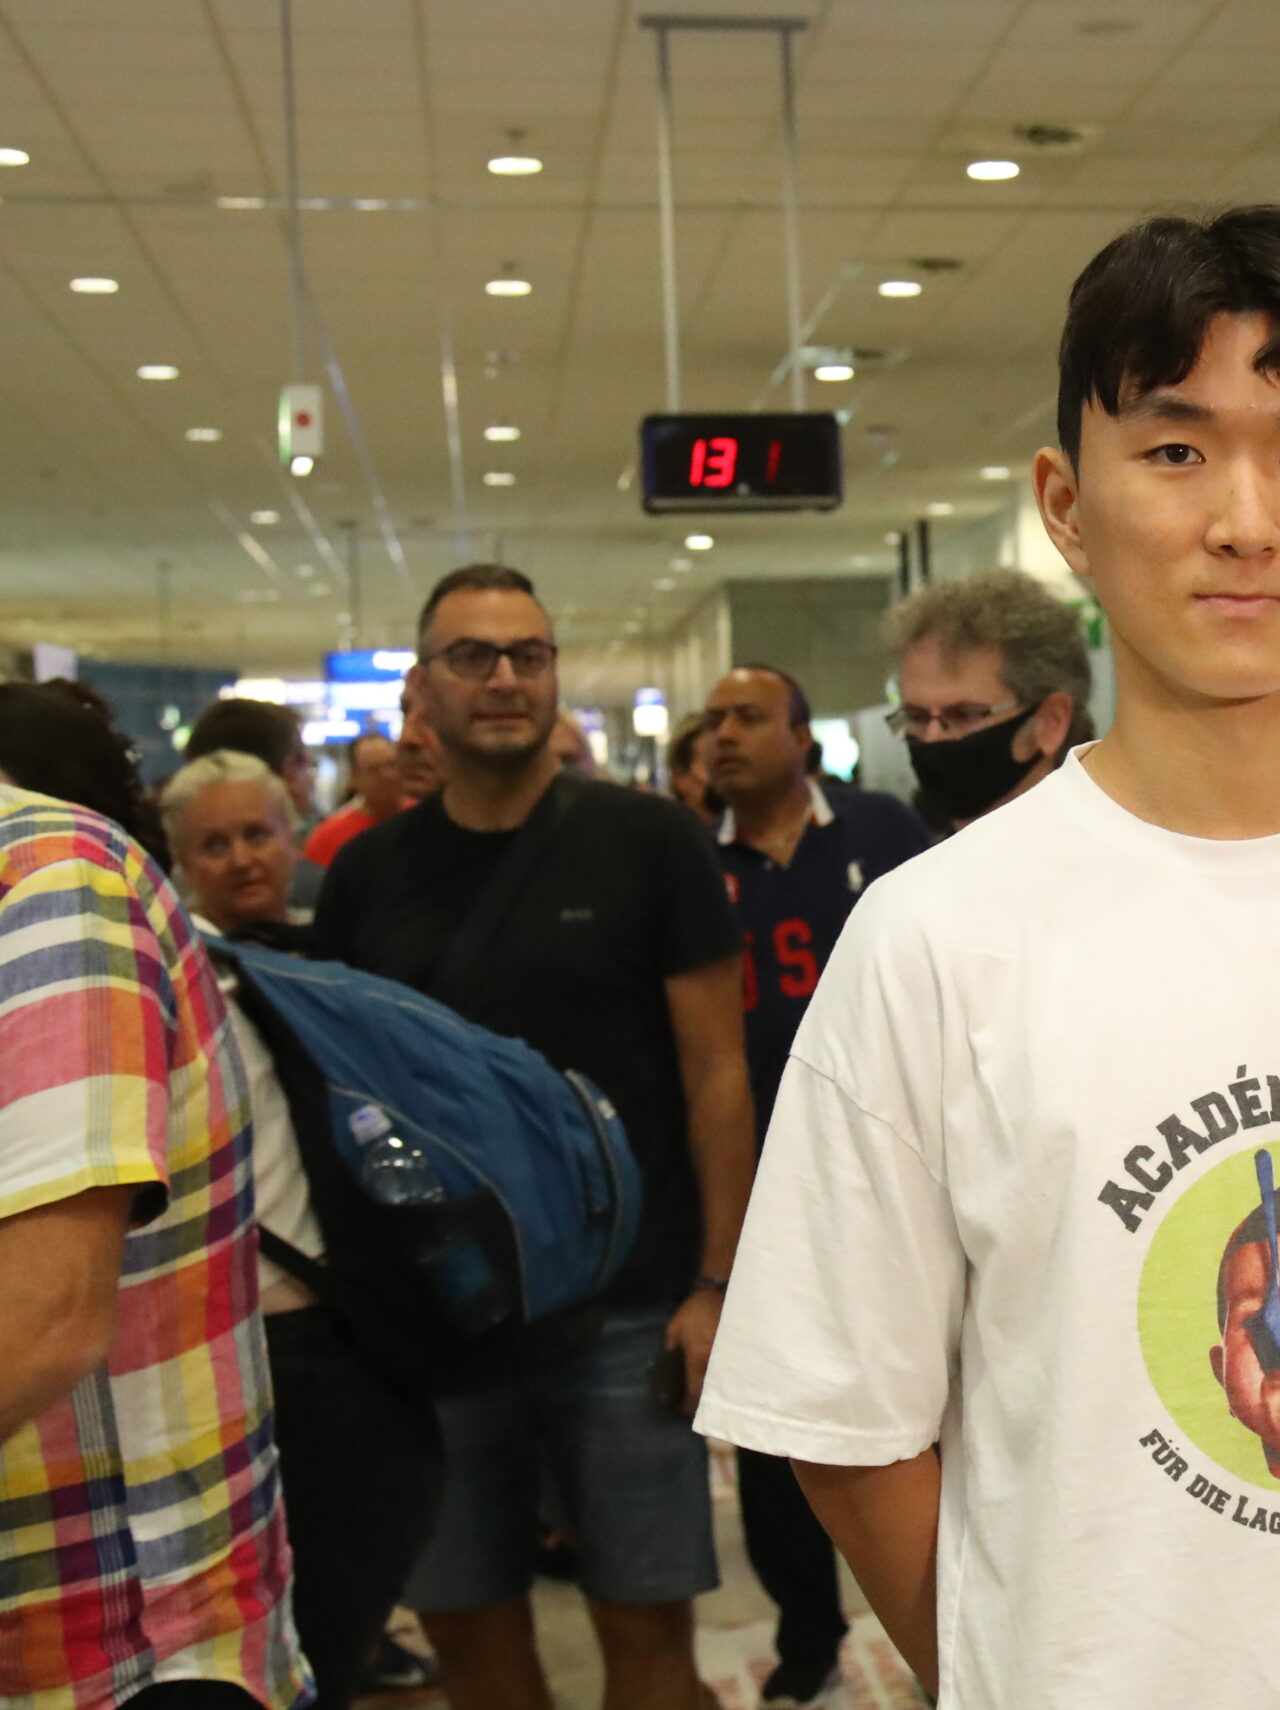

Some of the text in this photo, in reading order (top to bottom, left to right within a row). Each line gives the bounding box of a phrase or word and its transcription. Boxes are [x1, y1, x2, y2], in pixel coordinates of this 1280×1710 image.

[689, 437, 738, 488] 13
[1139, 1429, 1189, 1481] FÜR
[1186, 1474, 1231, 1515] DIE
